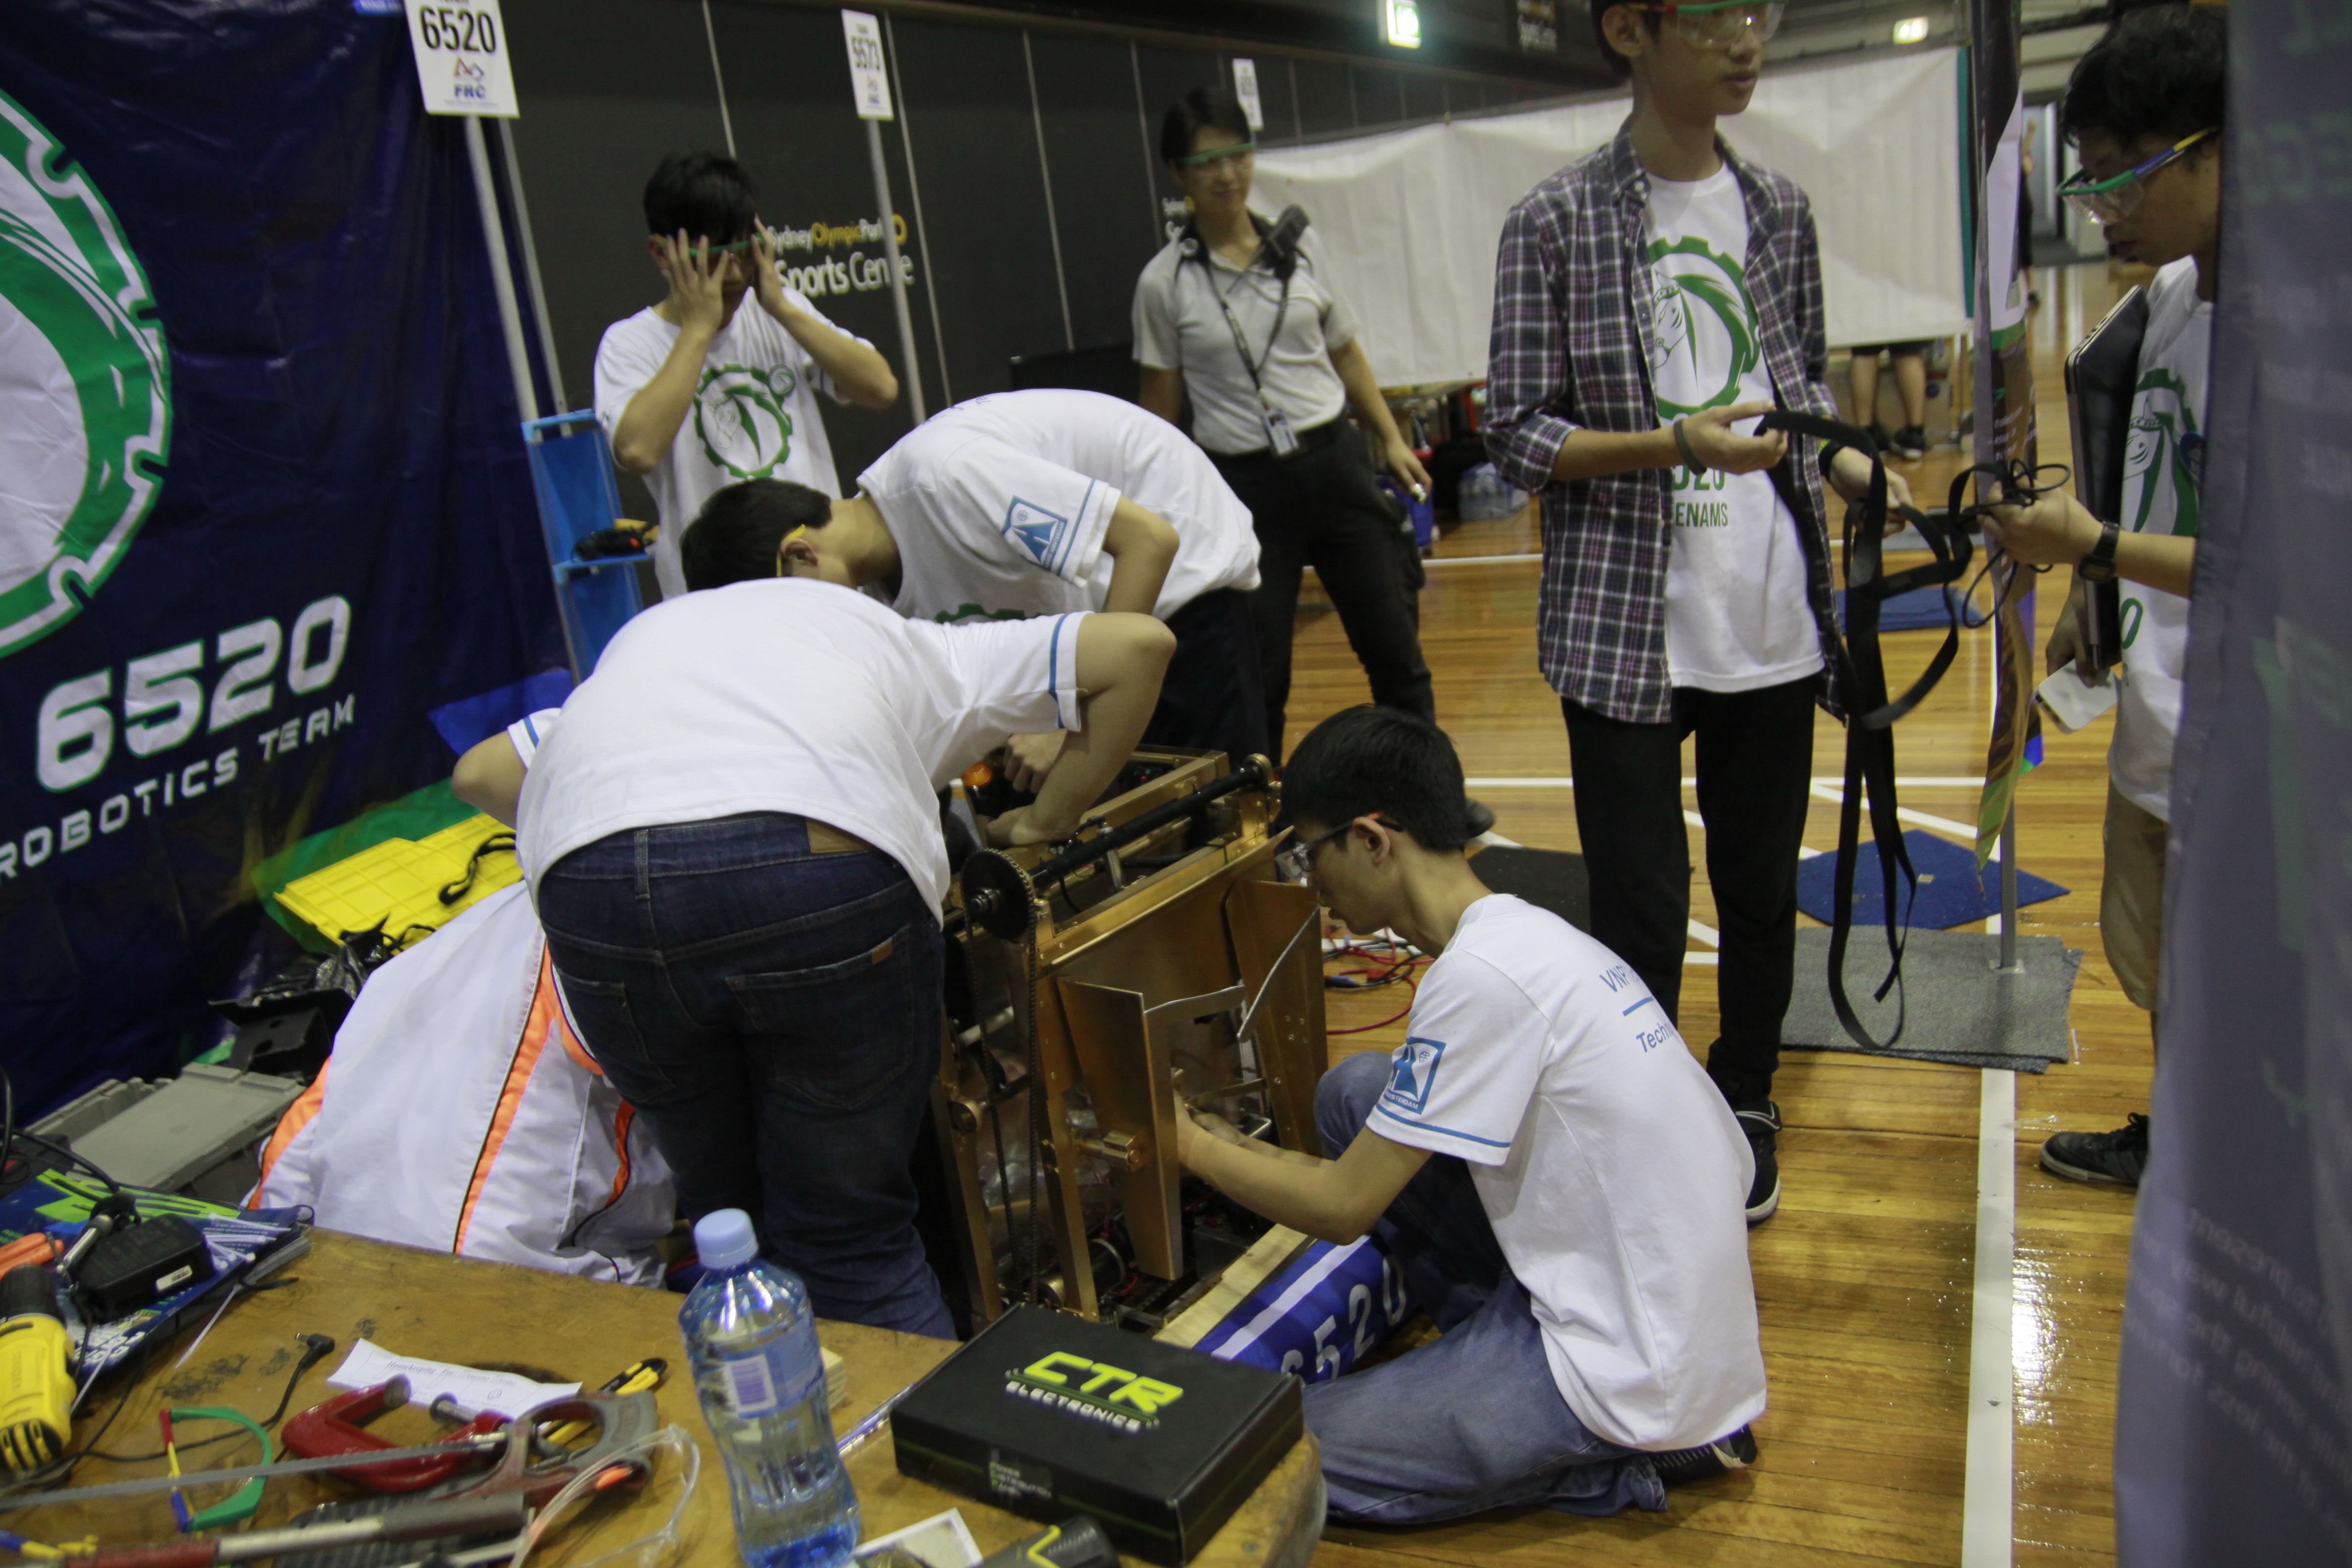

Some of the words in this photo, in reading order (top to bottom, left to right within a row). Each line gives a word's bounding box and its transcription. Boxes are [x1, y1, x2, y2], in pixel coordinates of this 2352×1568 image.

[420, 6, 496, 53] 6520
[774, 259, 850, 298] Sports
[36, 594, 352, 793] 6520
[0, 747, 239, 878] ROBOTICS
[257, 693, 355, 763] TEAM
[1005, 1380, 1141, 1433] ELECTRONICS
[1024, 1351, 1184, 1414] CTR
